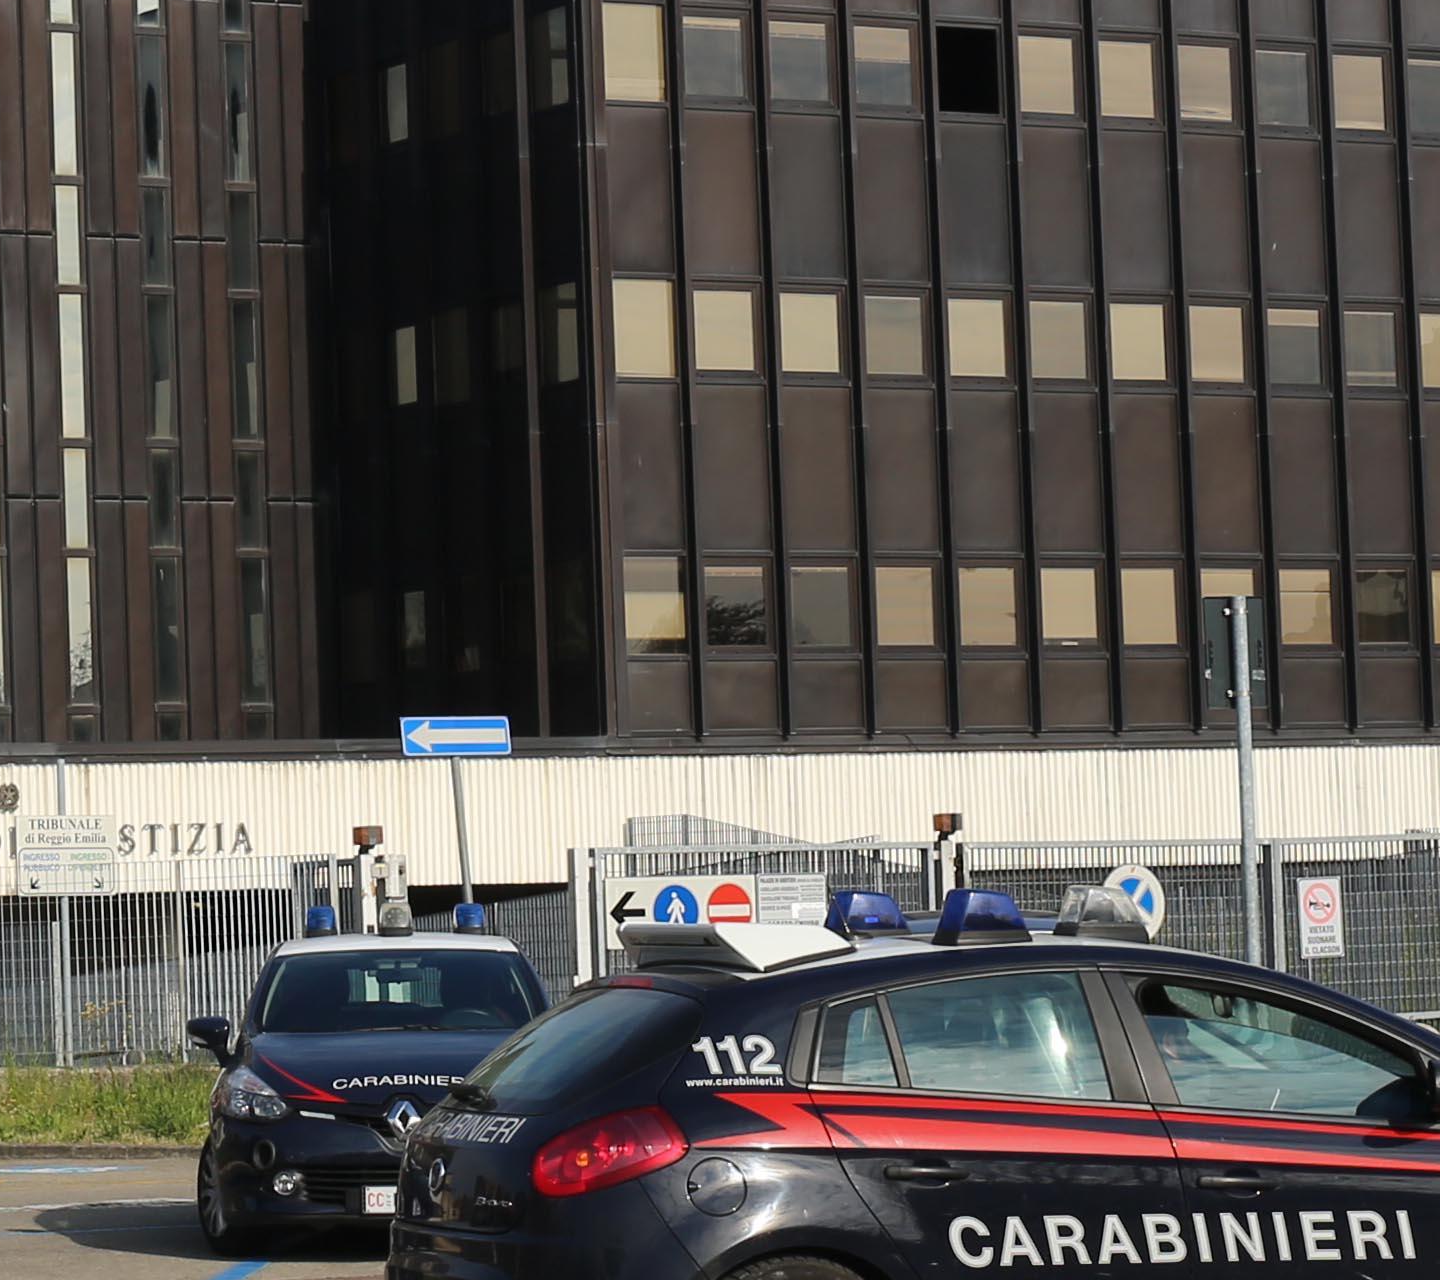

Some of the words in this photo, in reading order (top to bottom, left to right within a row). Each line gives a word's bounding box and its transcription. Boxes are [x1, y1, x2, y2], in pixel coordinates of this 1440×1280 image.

[28, 818, 102, 831] TRIBUNALE
[25, 832, 34, 843] di
[38, 832, 71, 846] Reggio
[75, 832, 106, 843] Emilia
[117, 822, 252, 857] STIZIA
[22, 852, 60, 861] INGRESSO
[1309, 925, 1334, 934] VIETATO
[1307, 935, 1336, 944] SUONARE
[1312, 945, 1340, 954] CLACSON
[691, 1034, 783, 1075] 112
[332, 1074, 465, 1090] CARABINIER
[685, 1076, 784, 1087] www.carabinieri.it
[367, 1192, 385, 1207] CC
[948, 1210, 1417, 1269] CARABINIERI
